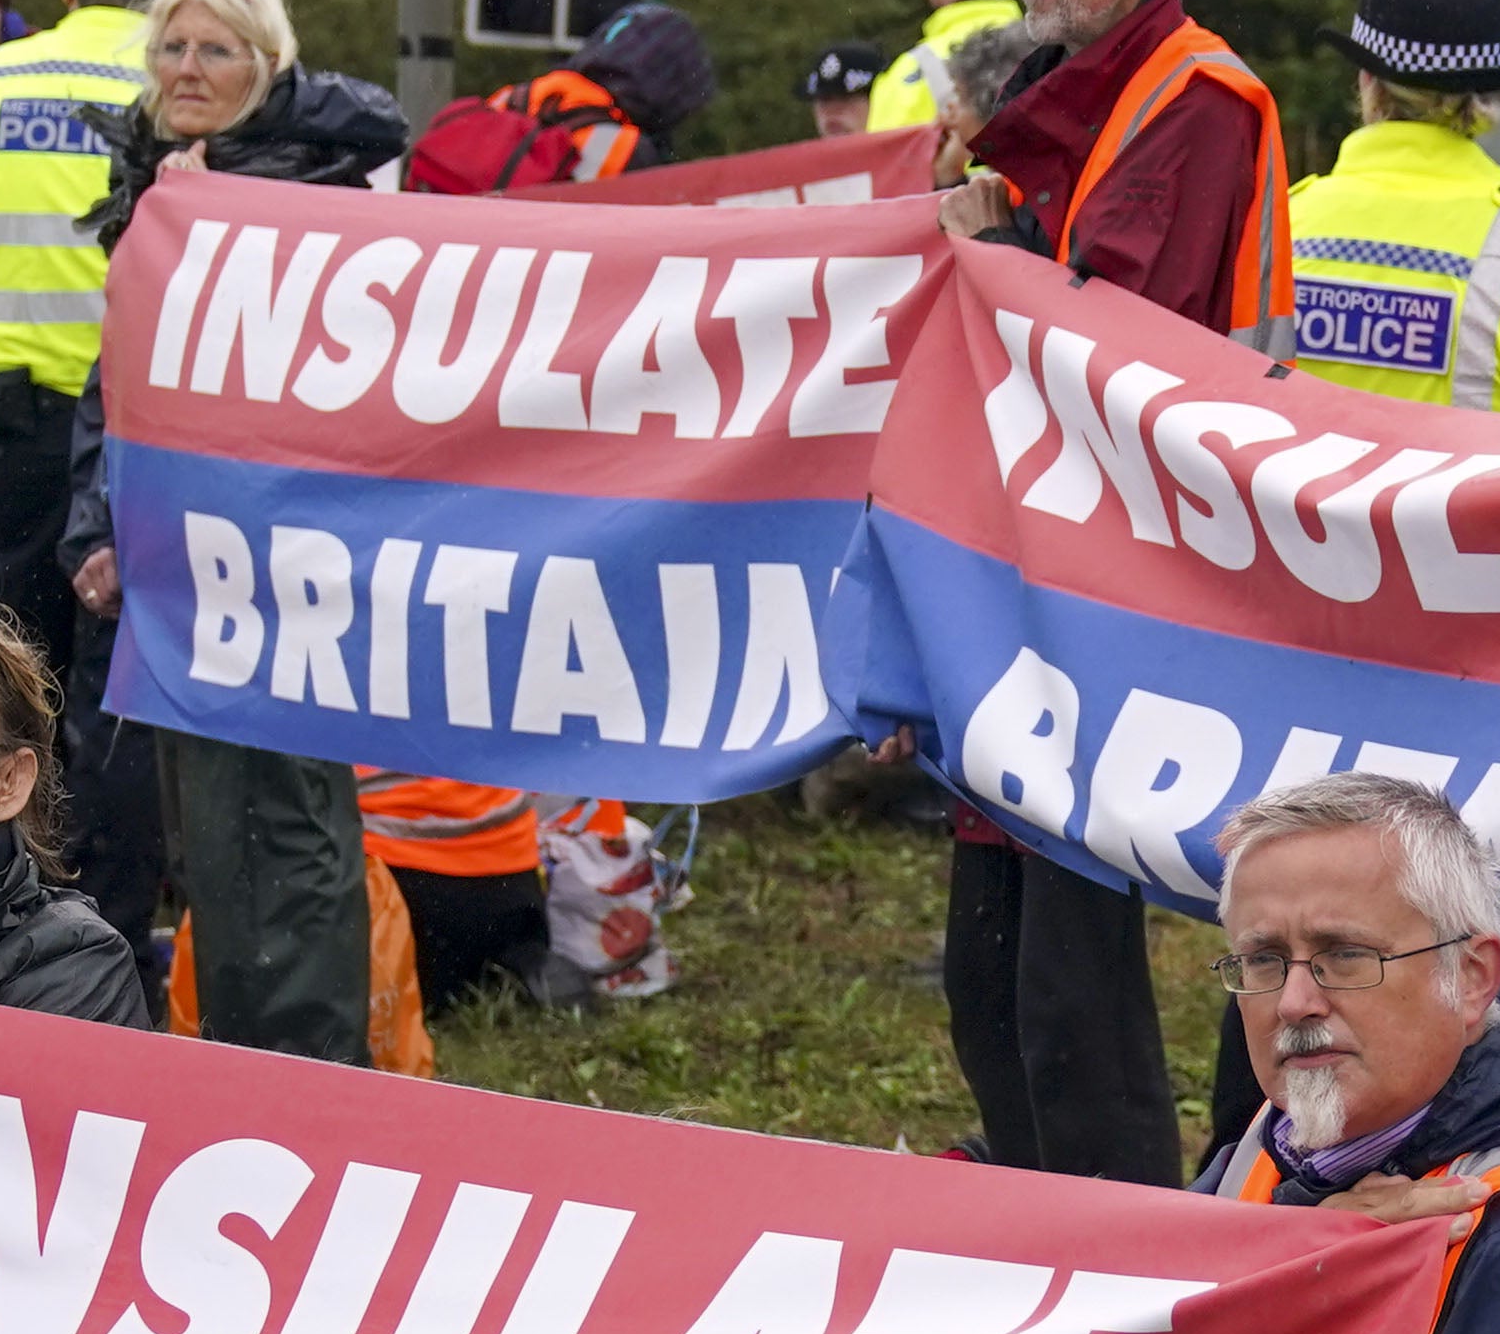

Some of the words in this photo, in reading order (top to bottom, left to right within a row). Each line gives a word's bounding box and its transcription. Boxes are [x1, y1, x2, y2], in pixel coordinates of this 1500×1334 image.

[148, 219, 923, 440] INSULATE
[1295, 284, 1440, 321] ETROPOLITAN
[184, 510, 841, 752] BRITAIN
